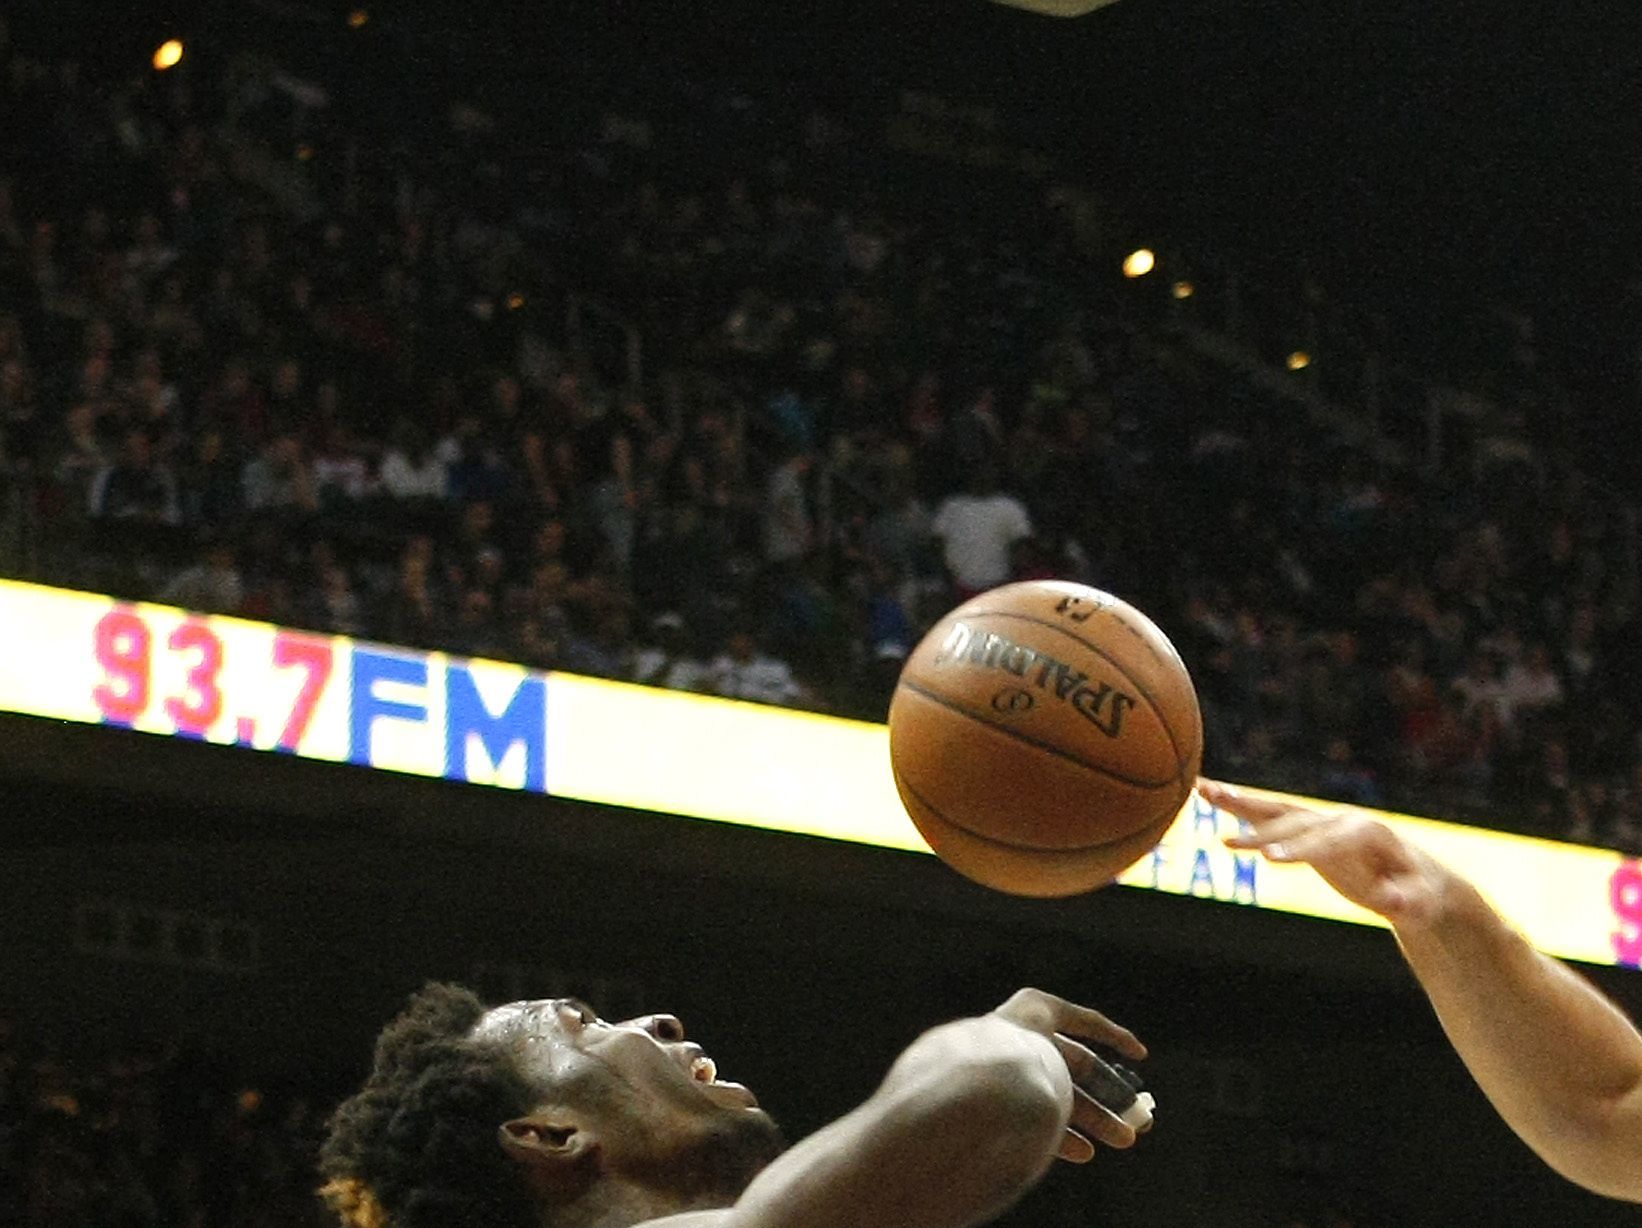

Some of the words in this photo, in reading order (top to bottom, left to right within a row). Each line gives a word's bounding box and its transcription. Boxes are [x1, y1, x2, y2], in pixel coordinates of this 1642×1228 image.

[94, 600, 334, 755] 93.7
[349, 639, 548, 794] FM
[940, 622, 1137, 739] SPALDING
